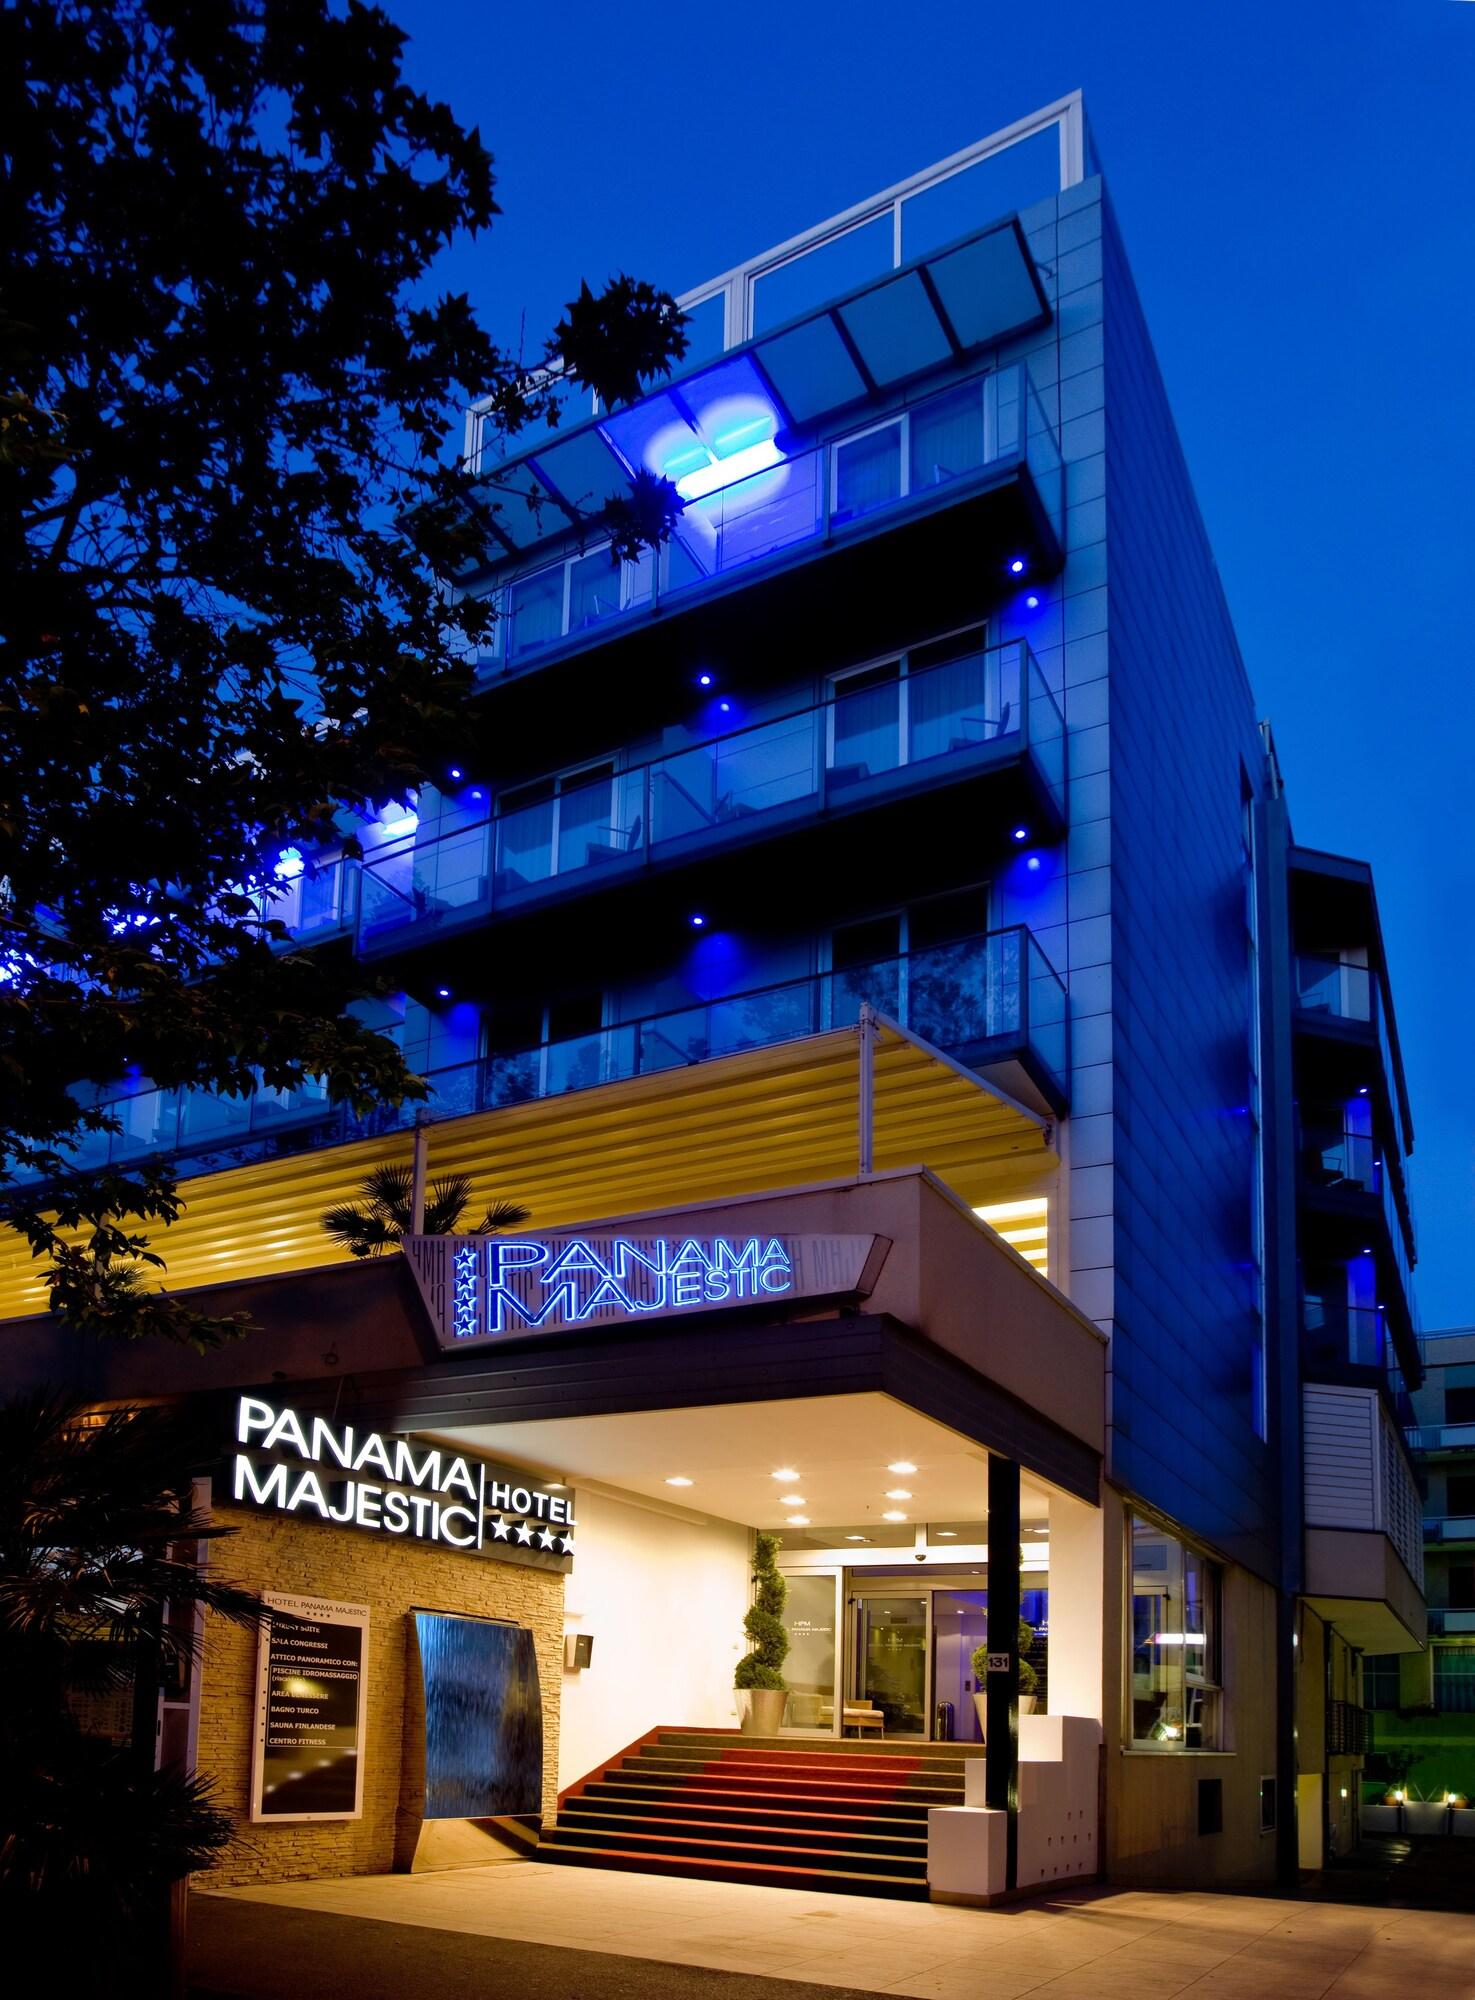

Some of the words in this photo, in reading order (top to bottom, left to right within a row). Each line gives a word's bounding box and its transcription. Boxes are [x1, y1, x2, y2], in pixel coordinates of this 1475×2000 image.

[488, 1238, 791, 1287] PANAMA
[488, 1265, 791, 1332] MAJESTIC
[238, 1395, 477, 1500] PANAMA
[234, 1453, 477, 1547] MAJESTIC
[491, 1480, 579, 1526] HOTEL
[267, 1597, 299, 1608] HOTEL
[300, 1601, 334, 1612] PANAMA
[335, 1606, 367, 1617] MAJESTIC
[300, 1625, 321, 1633] SUITE
[271, 1637, 289, 1646] SALA
[290, 1639, 329, 1650] CONGRESSI
[270, 1653, 297, 1662] ATTICO
[297, 1655, 342, 1666] PANORAMICO
[342, 1659, 359, 1668] CON:
[989, 1657, 1008, 1668] 131
[272, 1667, 301, 1676] PISCINE
[302, 1670, 358, 1681] IDROMASSAGGIO
[271, 1690, 290, 1698] AREA
[270, 1706, 296, 1714] BAGNO
[296, 1707, 320, 1715] TURCO
[269, 1721, 294, 1730] SAUNA
[294, 1722, 336, 1731] FINLANDESE
[269, 1737, 297, 1745] CENTRO
[298, 1738, 327, 1746] FITNESS
